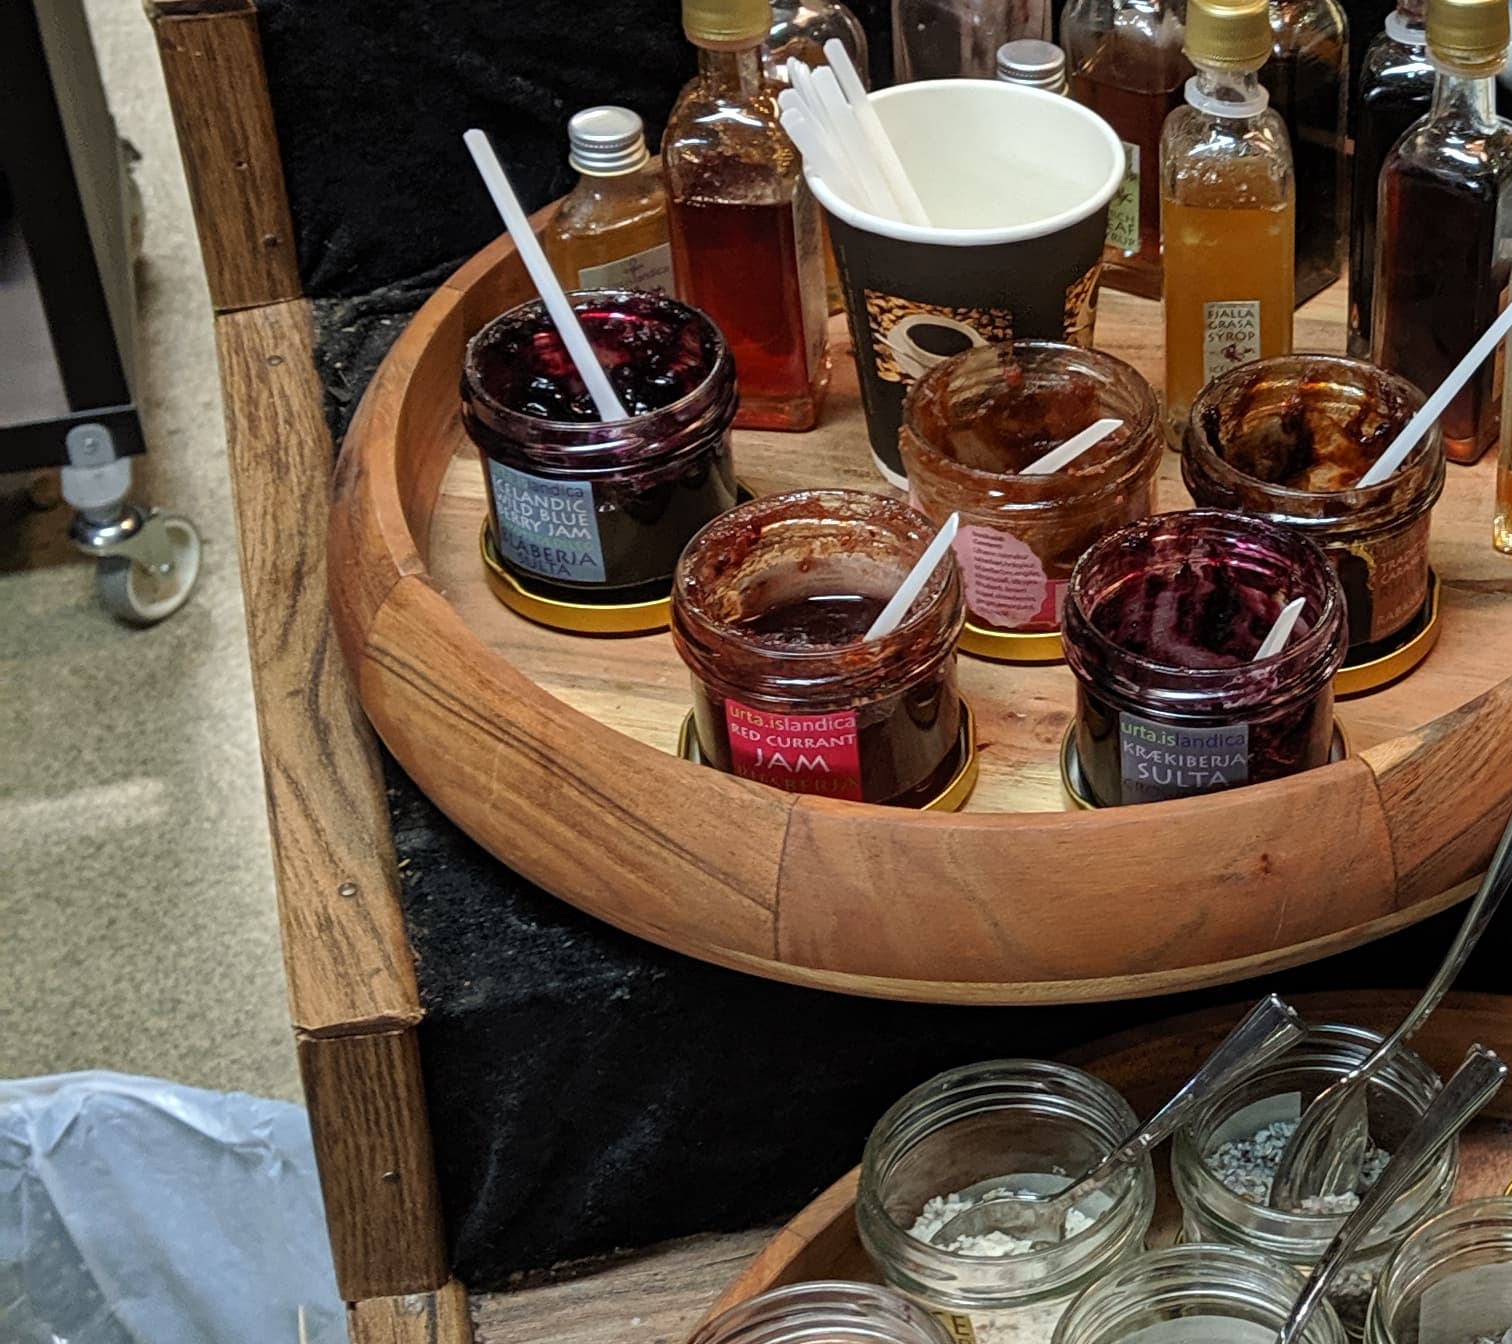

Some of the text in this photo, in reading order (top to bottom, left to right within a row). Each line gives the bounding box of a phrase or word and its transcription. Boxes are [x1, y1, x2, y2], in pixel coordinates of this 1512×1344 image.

[1208, 310, 1254, 319] FJALLA
[1208, 320, 1254, 329] GRASA
[496, 479, 586, 513] CELANDIC
[540, 510, 588, 526] BLUE
[549, 524, 591, 539] JAM
[729, 706, 856, 732] urta.islandica
[731, 723, 856, 748] RED CURRANT
[1121, 722, 1247, 748] urta.islandica
[755, 748, 830, 772] JAM
[1123, 739, 1247, 768] KRÆKIBERJA
[1138, 763, 1227, 787] SULTA
